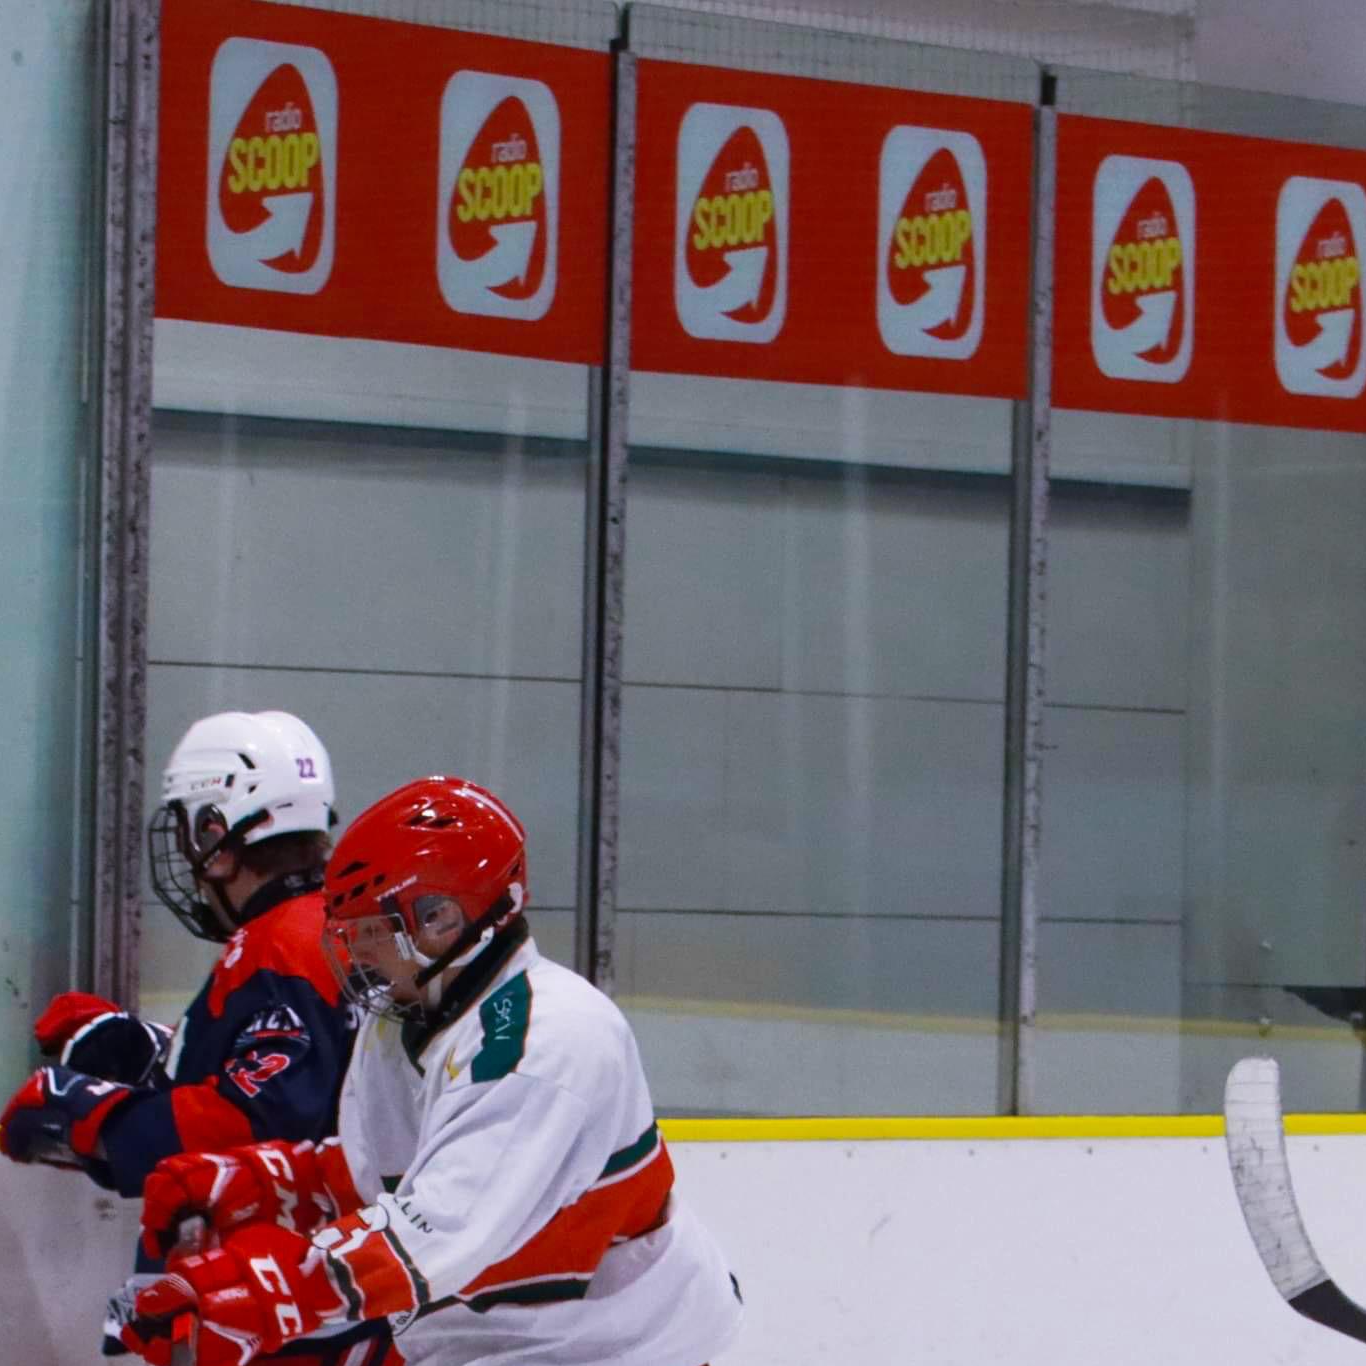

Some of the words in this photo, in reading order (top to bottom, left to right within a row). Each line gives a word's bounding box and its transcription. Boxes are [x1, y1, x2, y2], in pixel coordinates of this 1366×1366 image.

[266, 101, 302, 133] radio
[228, 132, 319, 193] SCOOP
[491, 134, 527, 164] radio
[725, 163, 759, 191] radio
[457, 162, 542, 223] SCOOP
[693, 189, 774, 250] SCOOP
[895, 210, 972, 268] SCOOP
[1108, 237, 1181, 294] SCOOP
[1290, 257, 1360, 313] SCOOP
[296, 757, 317, 779] 22
